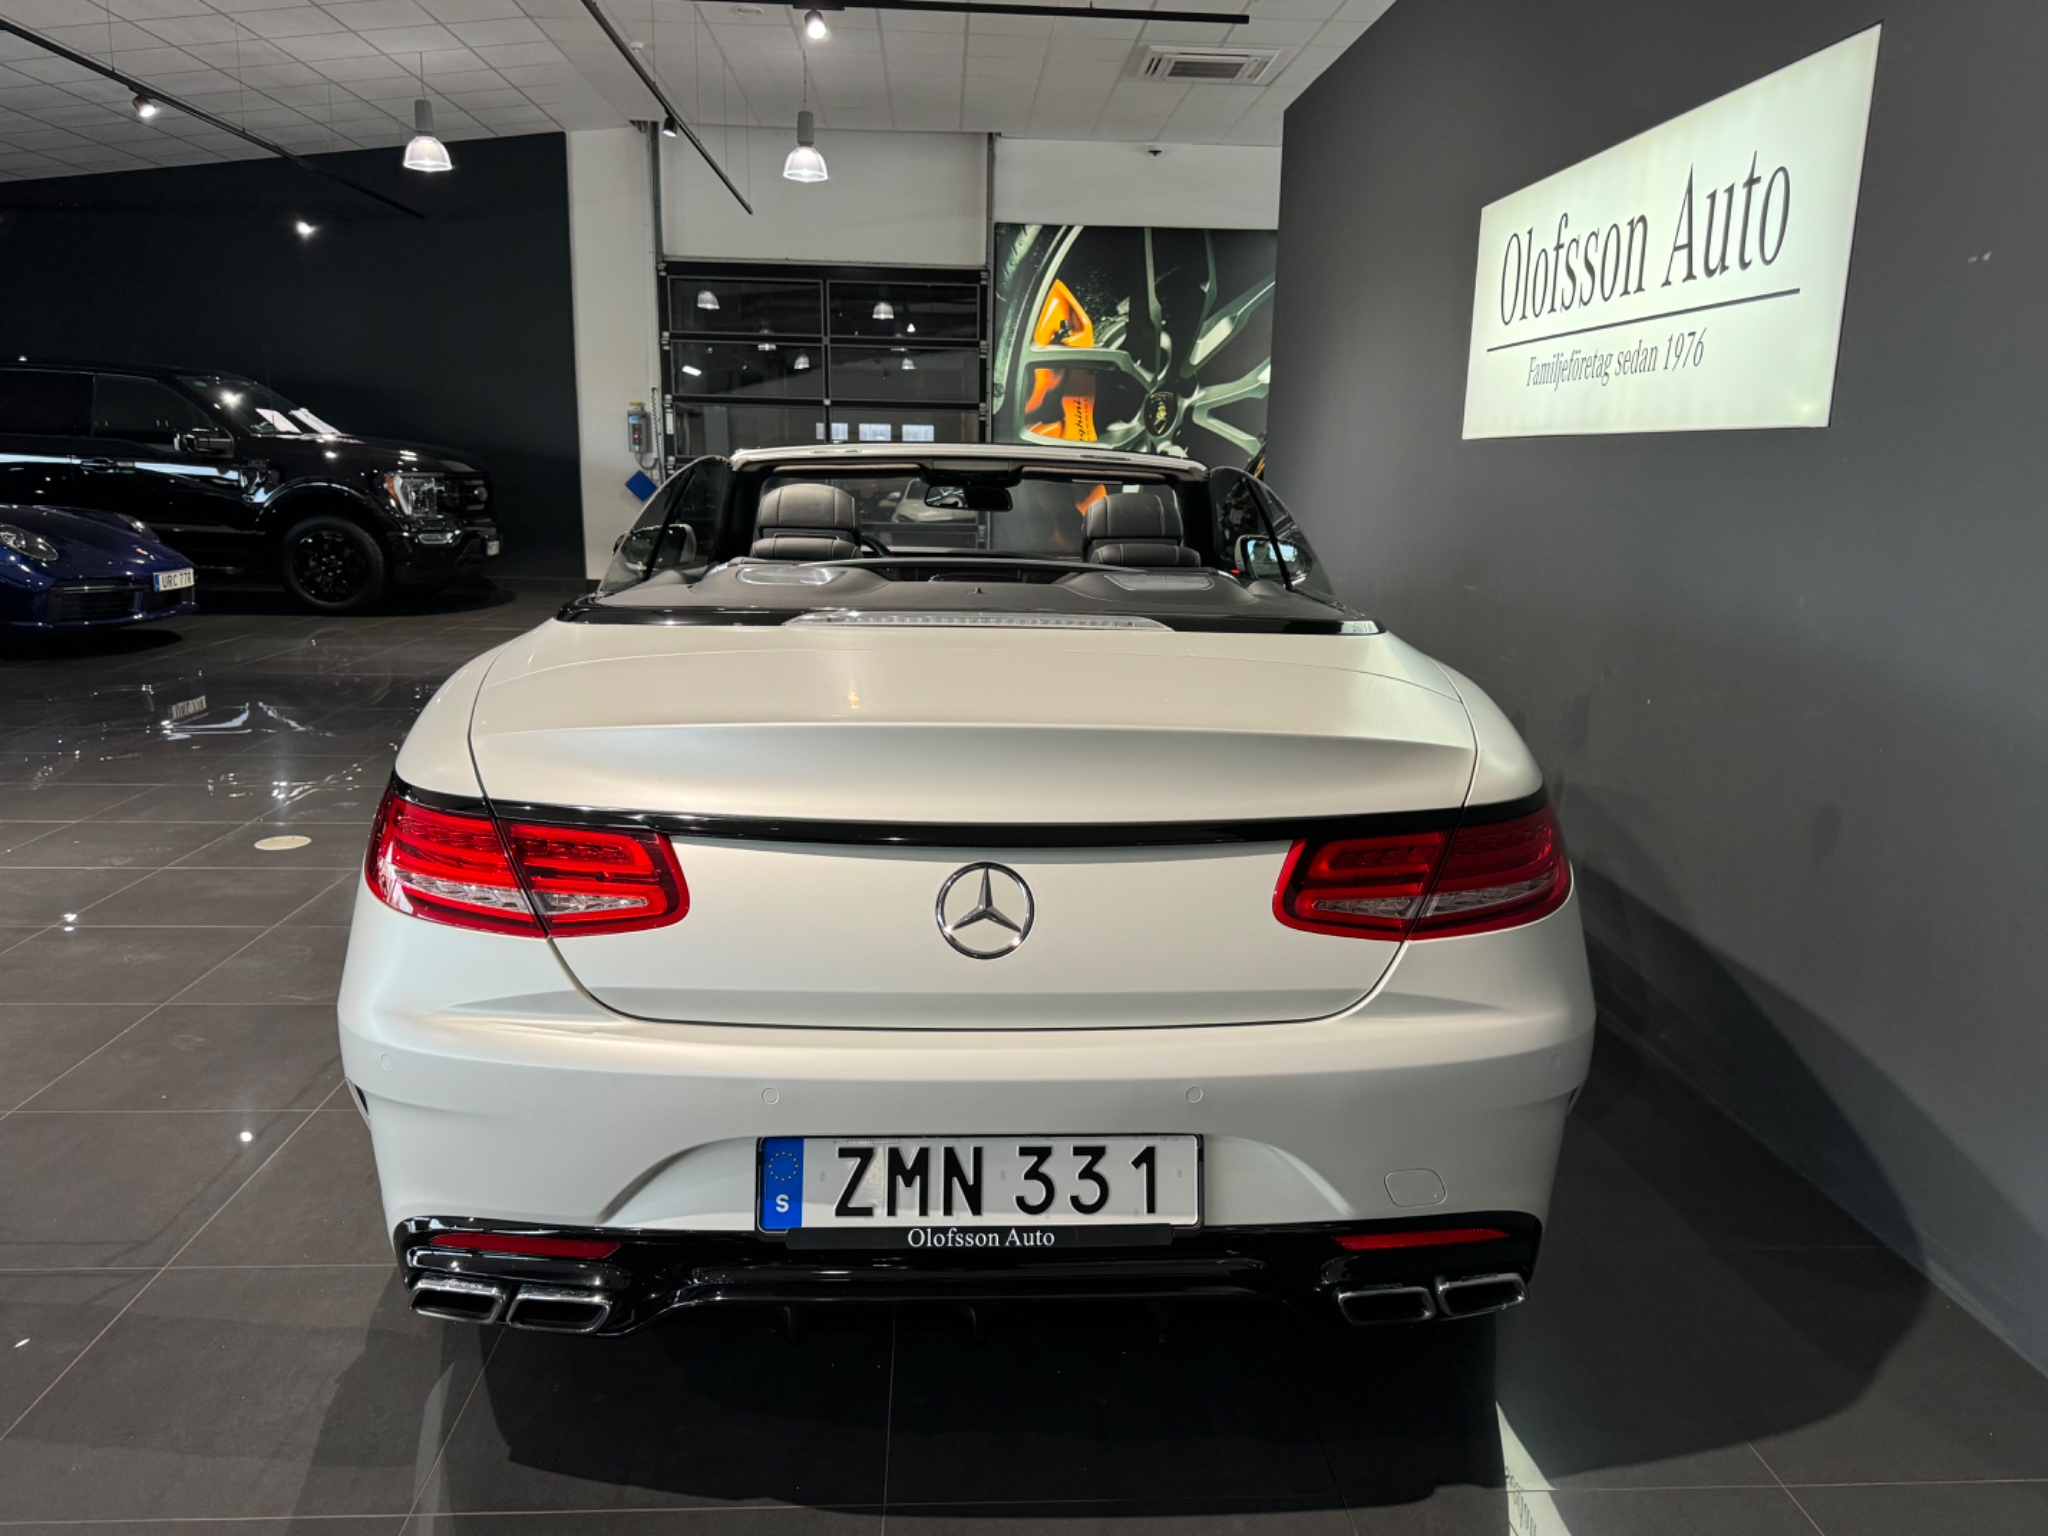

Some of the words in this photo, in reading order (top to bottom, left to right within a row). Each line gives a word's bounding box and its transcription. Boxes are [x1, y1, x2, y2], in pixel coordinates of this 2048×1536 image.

[1500, 212, 1648, 326] Olofsson
[1660, 150, 1791, 288] Auto
[1526, 349, 1613, 391] Familjeföretag
[1614, 338, 1658, 376] sedan
[1662, 327, 1707, 371] 1976
[775, 1194, 790, 1213] S
[835, 1146, 983, 1217] ZMN
[1015, 1145, 1156, 1215] 331
[907, 1227, 1000, 1248] Olofsson
[1005, 1227, 1056, 1248] Auto
